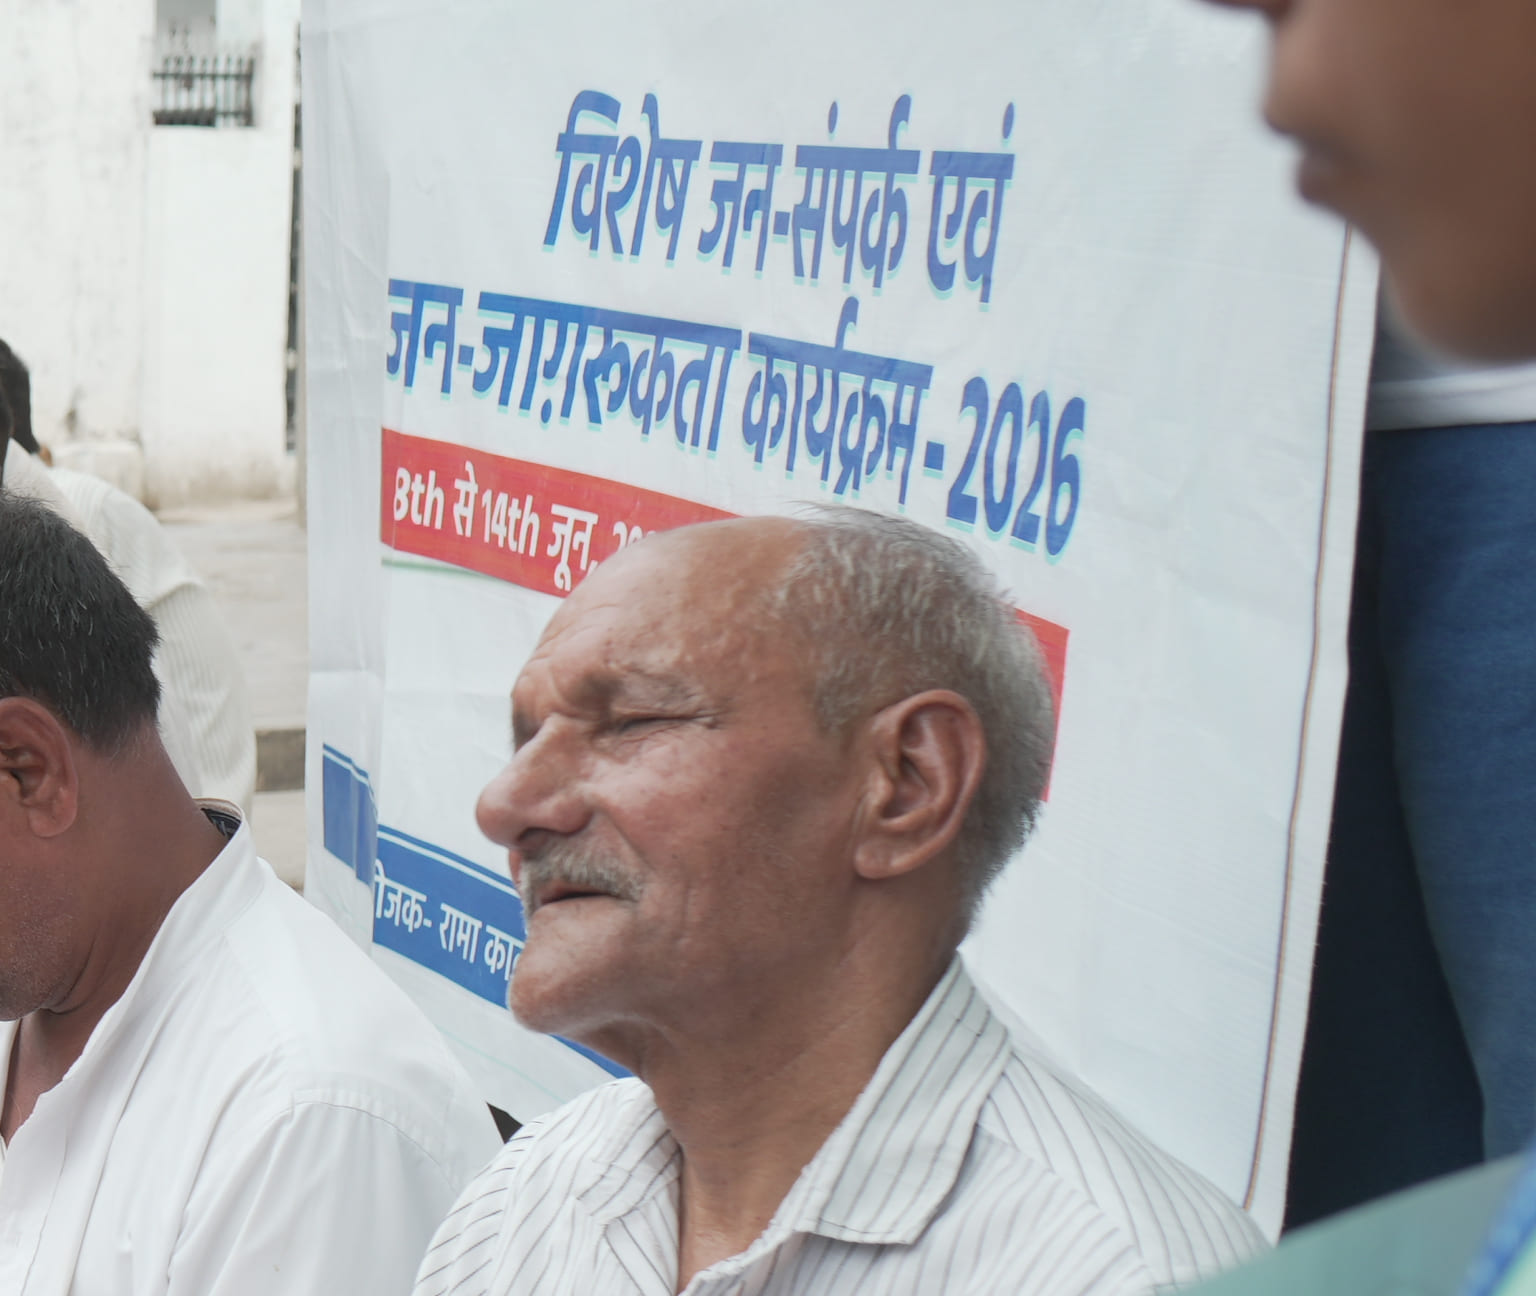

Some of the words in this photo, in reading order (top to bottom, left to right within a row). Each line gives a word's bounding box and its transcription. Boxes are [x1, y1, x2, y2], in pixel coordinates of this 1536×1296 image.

[543, 90, 703, 258] विशेष
[697, 94, 921, 288] जन-संपर्क
[927, 102, 1016, 304] एवं
[393, 467, 445, 530] 8th
[453, 461, 478, 538] से
[482, 488, 540, 557] 14th
[439, 902, 483, 964] रामा
